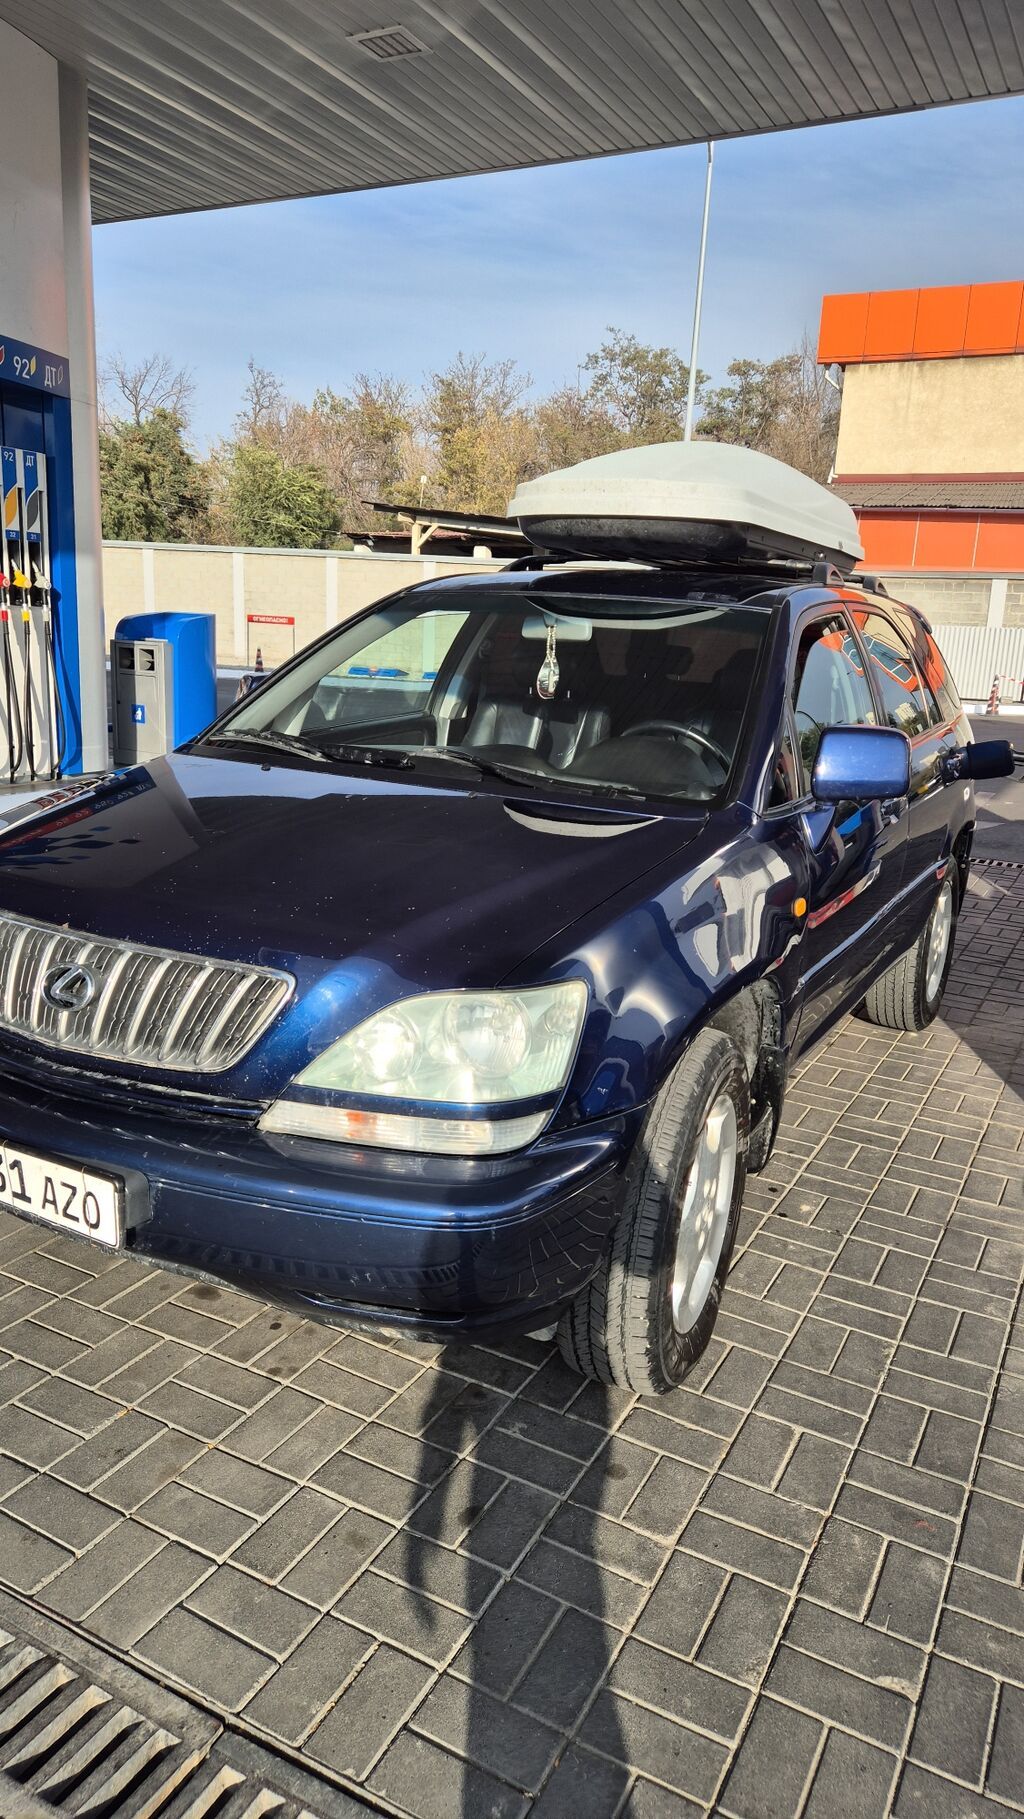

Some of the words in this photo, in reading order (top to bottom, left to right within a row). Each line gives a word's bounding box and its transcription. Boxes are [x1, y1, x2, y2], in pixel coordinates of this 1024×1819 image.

[13, 355, 30, 379] 92
[44, 365, 57, 388] ДТ
[3, 451, 14, 462] 92
[25, 455, 35, 467] ДТ
